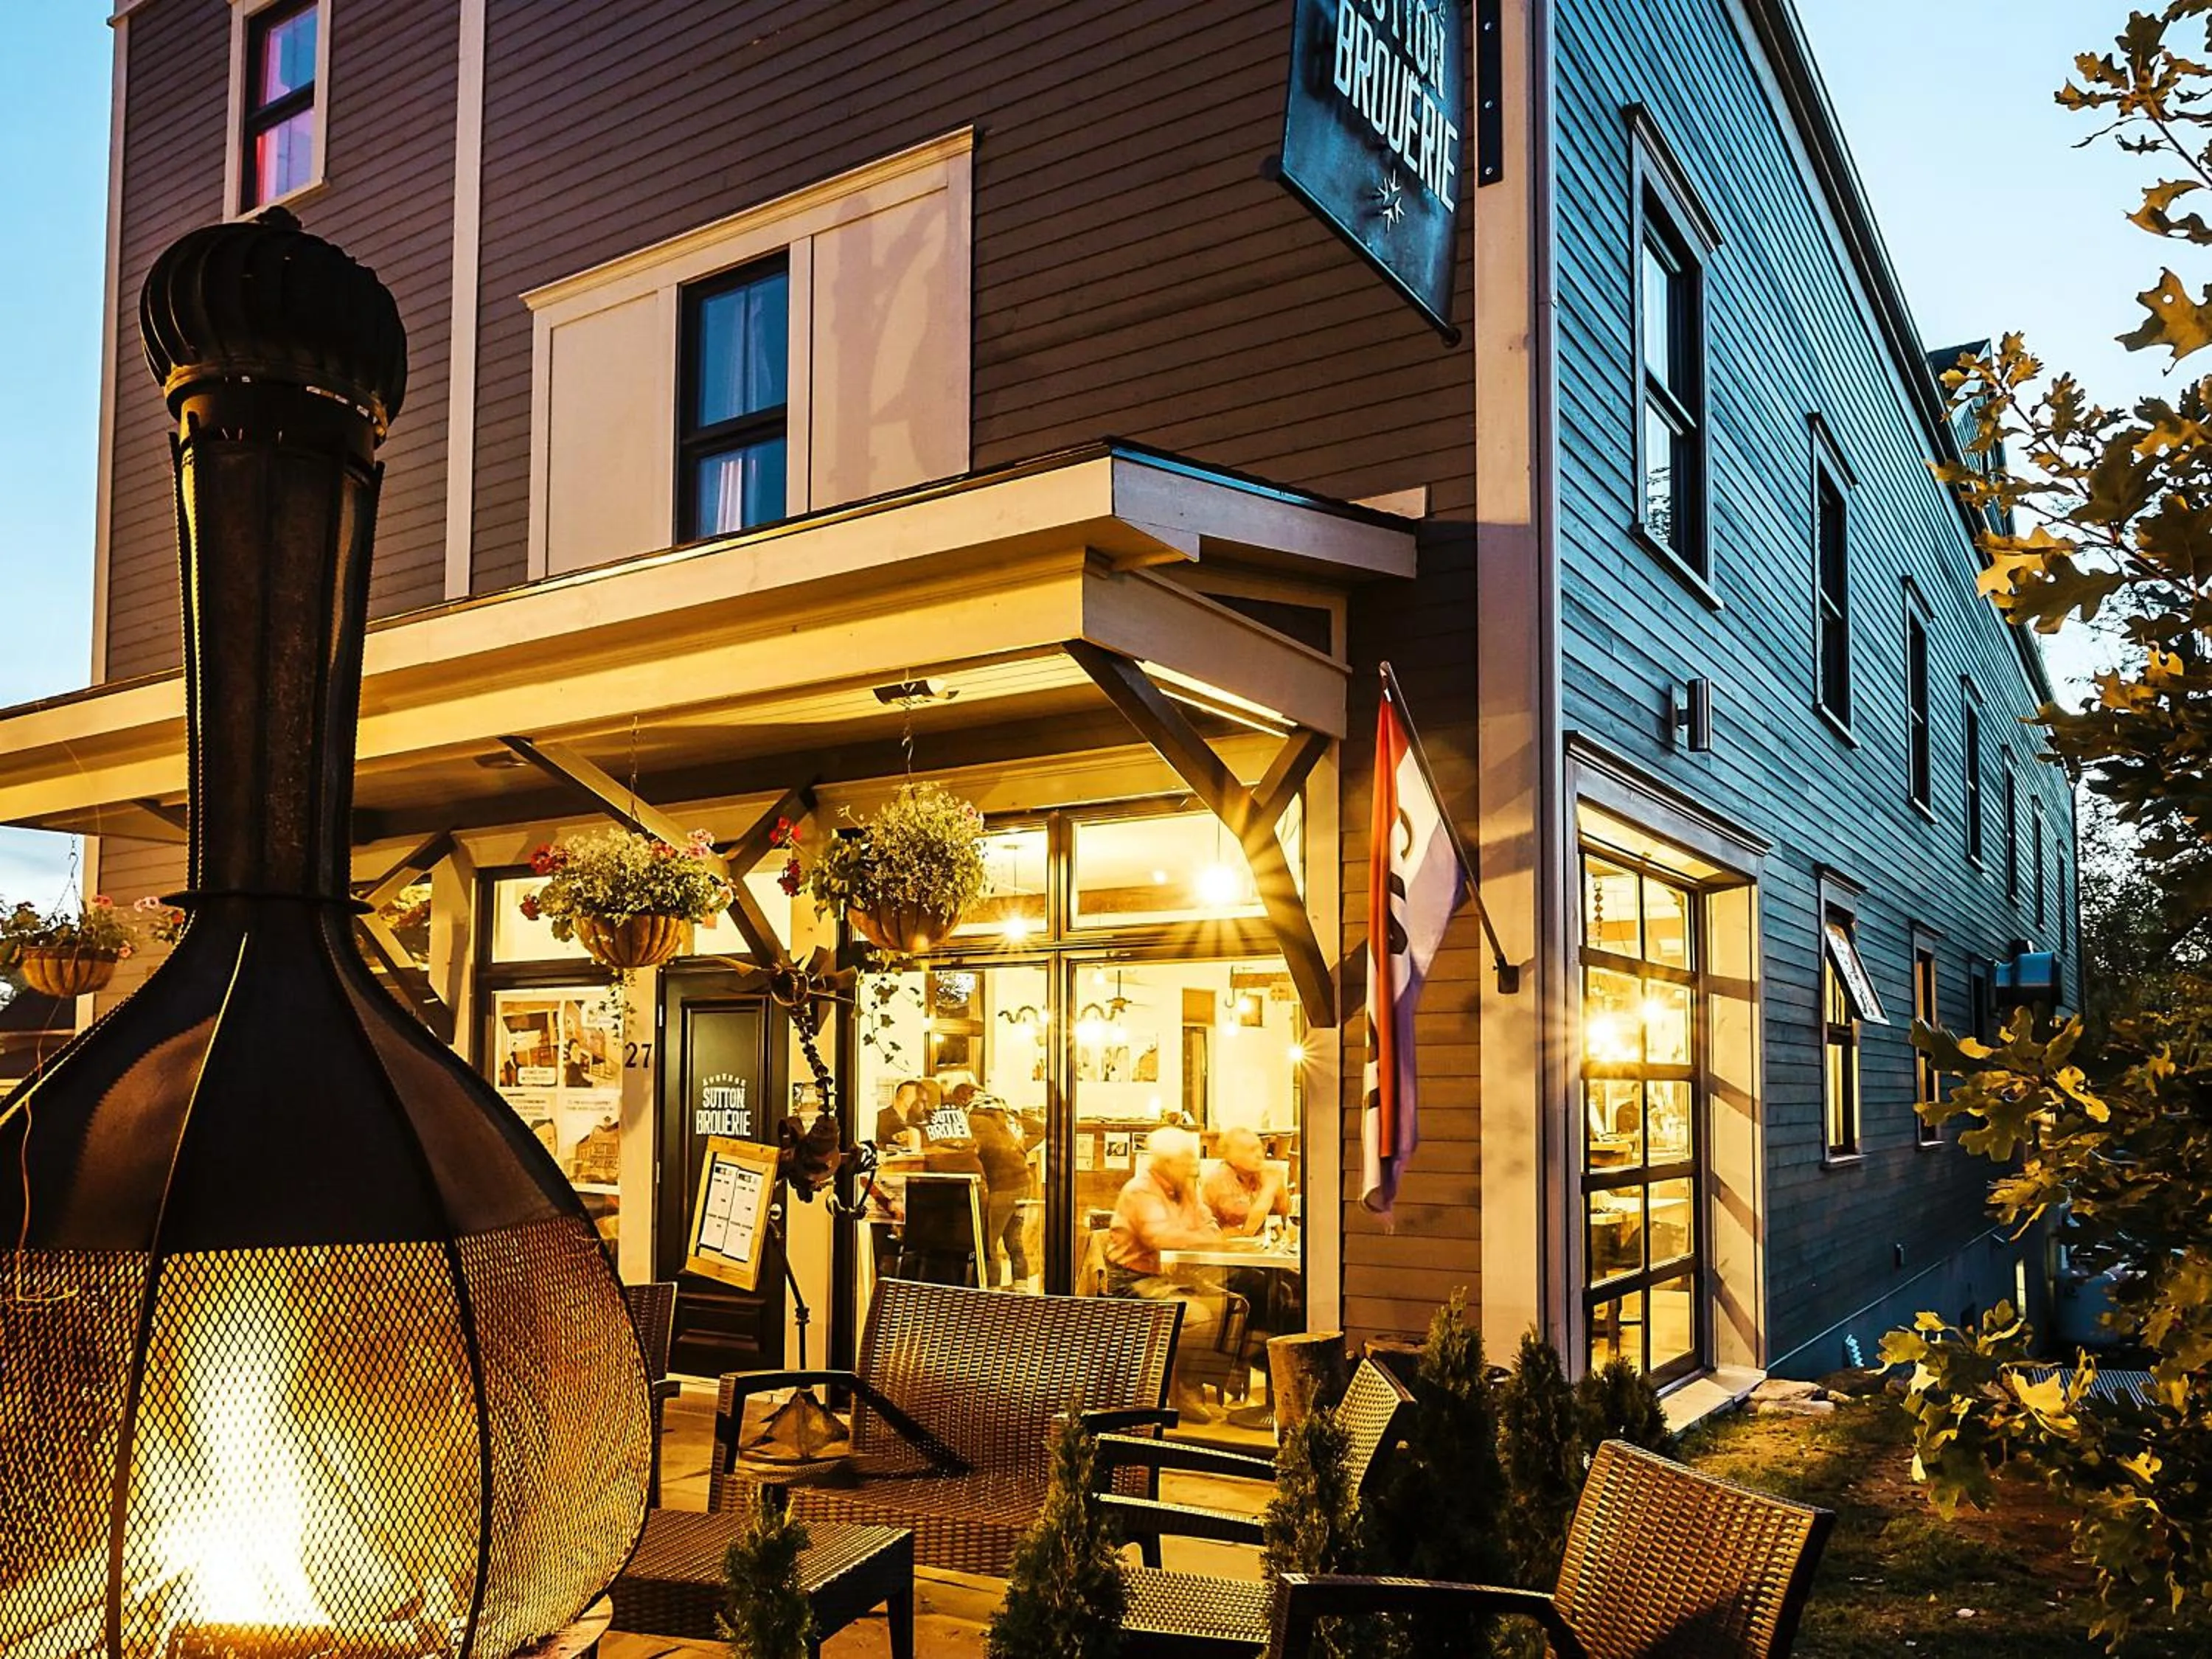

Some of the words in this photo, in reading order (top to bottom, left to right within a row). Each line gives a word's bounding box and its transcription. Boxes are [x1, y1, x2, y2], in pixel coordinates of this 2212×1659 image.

[1362, 0, 1446, 100] TON
[625, 1042, 653, 1068] 27
[702, 1087, 745, 1108] SUTTON
[931, 1109, 970, 1124] SUTT
